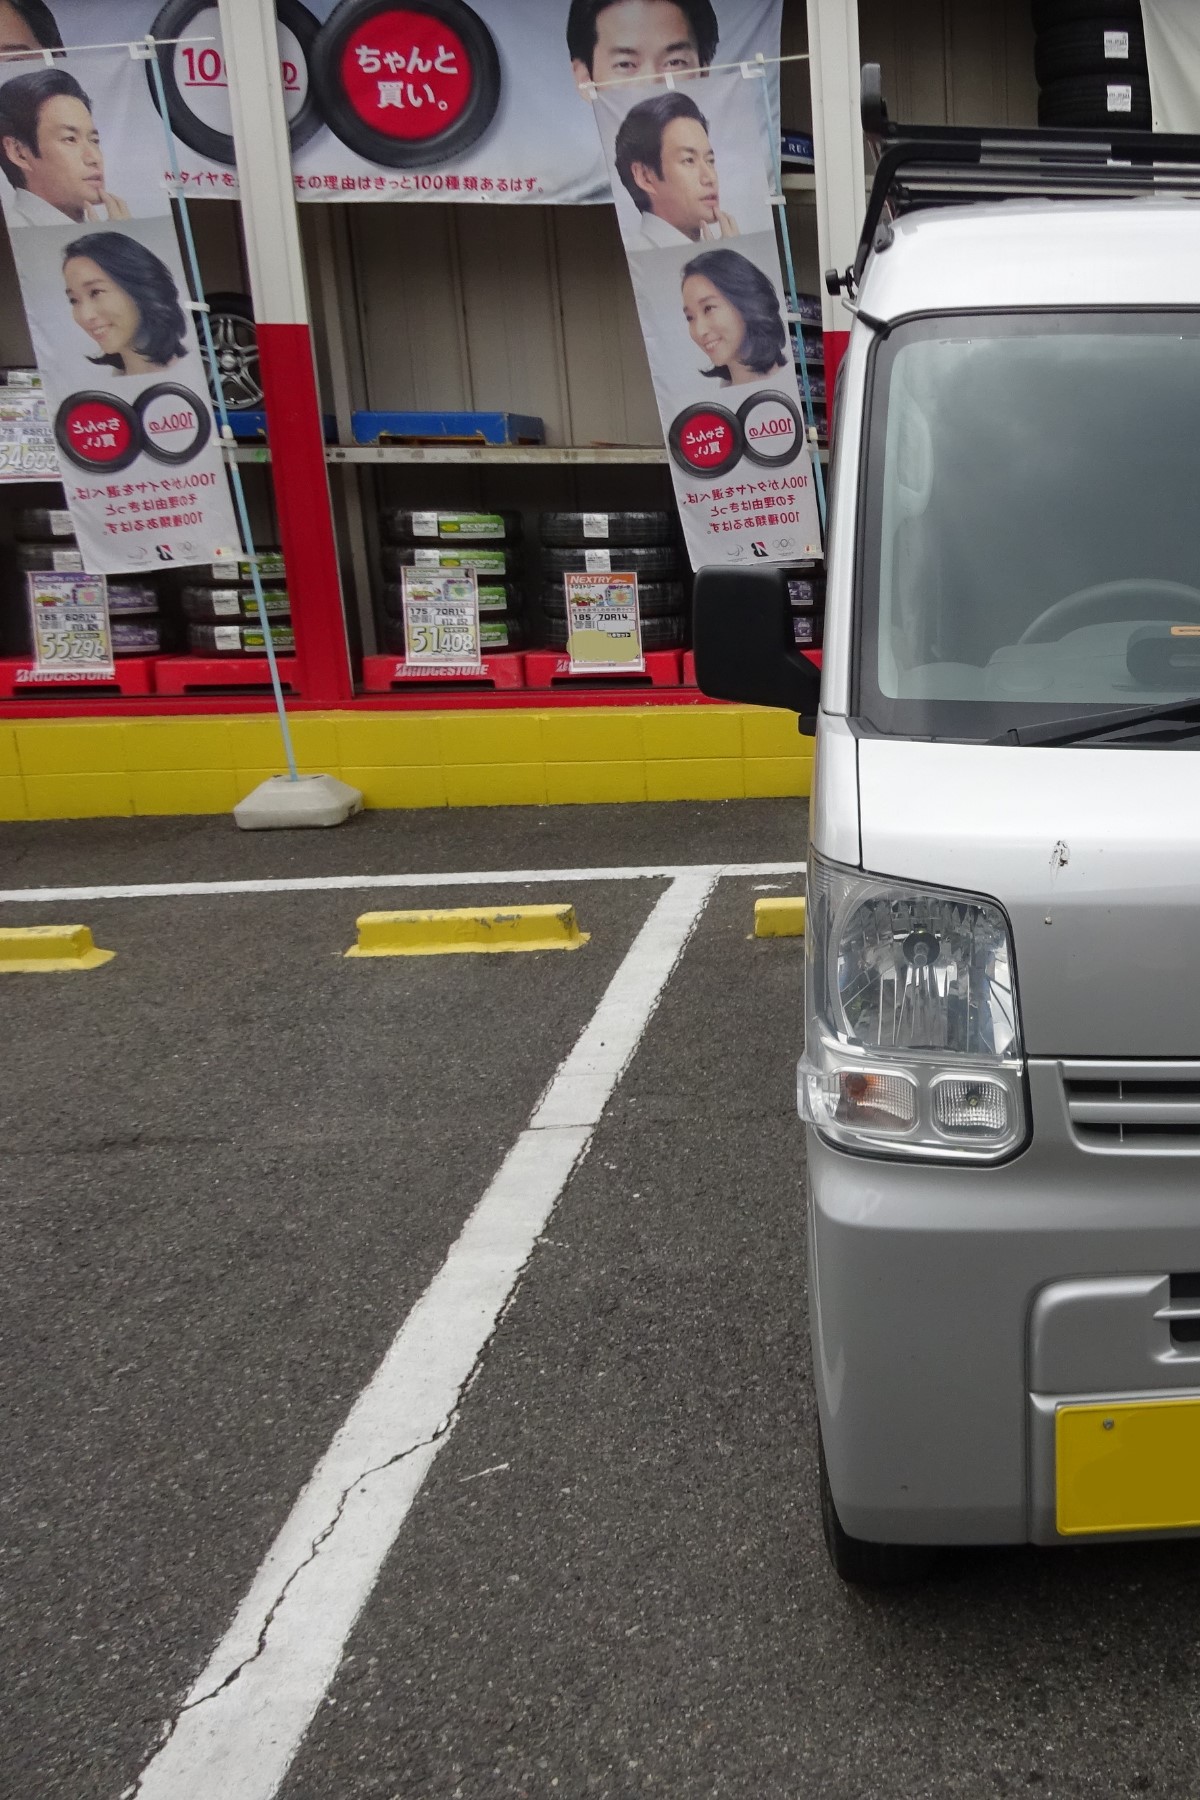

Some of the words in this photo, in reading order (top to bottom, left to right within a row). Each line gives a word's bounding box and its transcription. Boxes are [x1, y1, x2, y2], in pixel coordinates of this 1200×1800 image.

[355, 45, 458, 74] ちゃんと
[377, 81, 448, 111] 買い。
